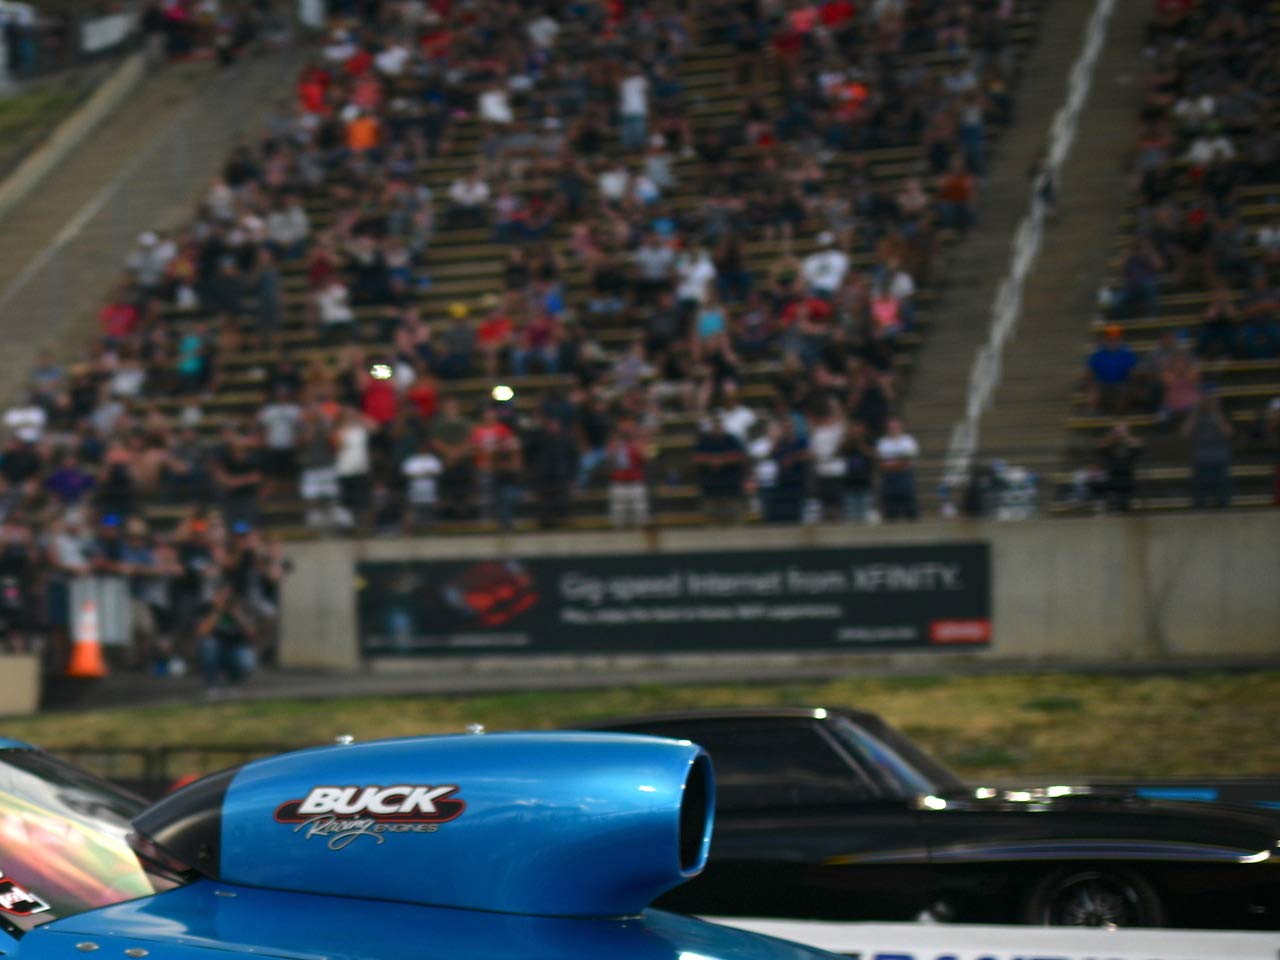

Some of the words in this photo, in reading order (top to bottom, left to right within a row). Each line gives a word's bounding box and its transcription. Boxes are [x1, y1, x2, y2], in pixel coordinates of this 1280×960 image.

[687, 571, 780, 597] Internet
[787, 565, 846, 594] from
[297, 786, 457, 815] BUCK
[294, 815, 384, 850] Racing
[373, 823, 439, 833] ENGINES
